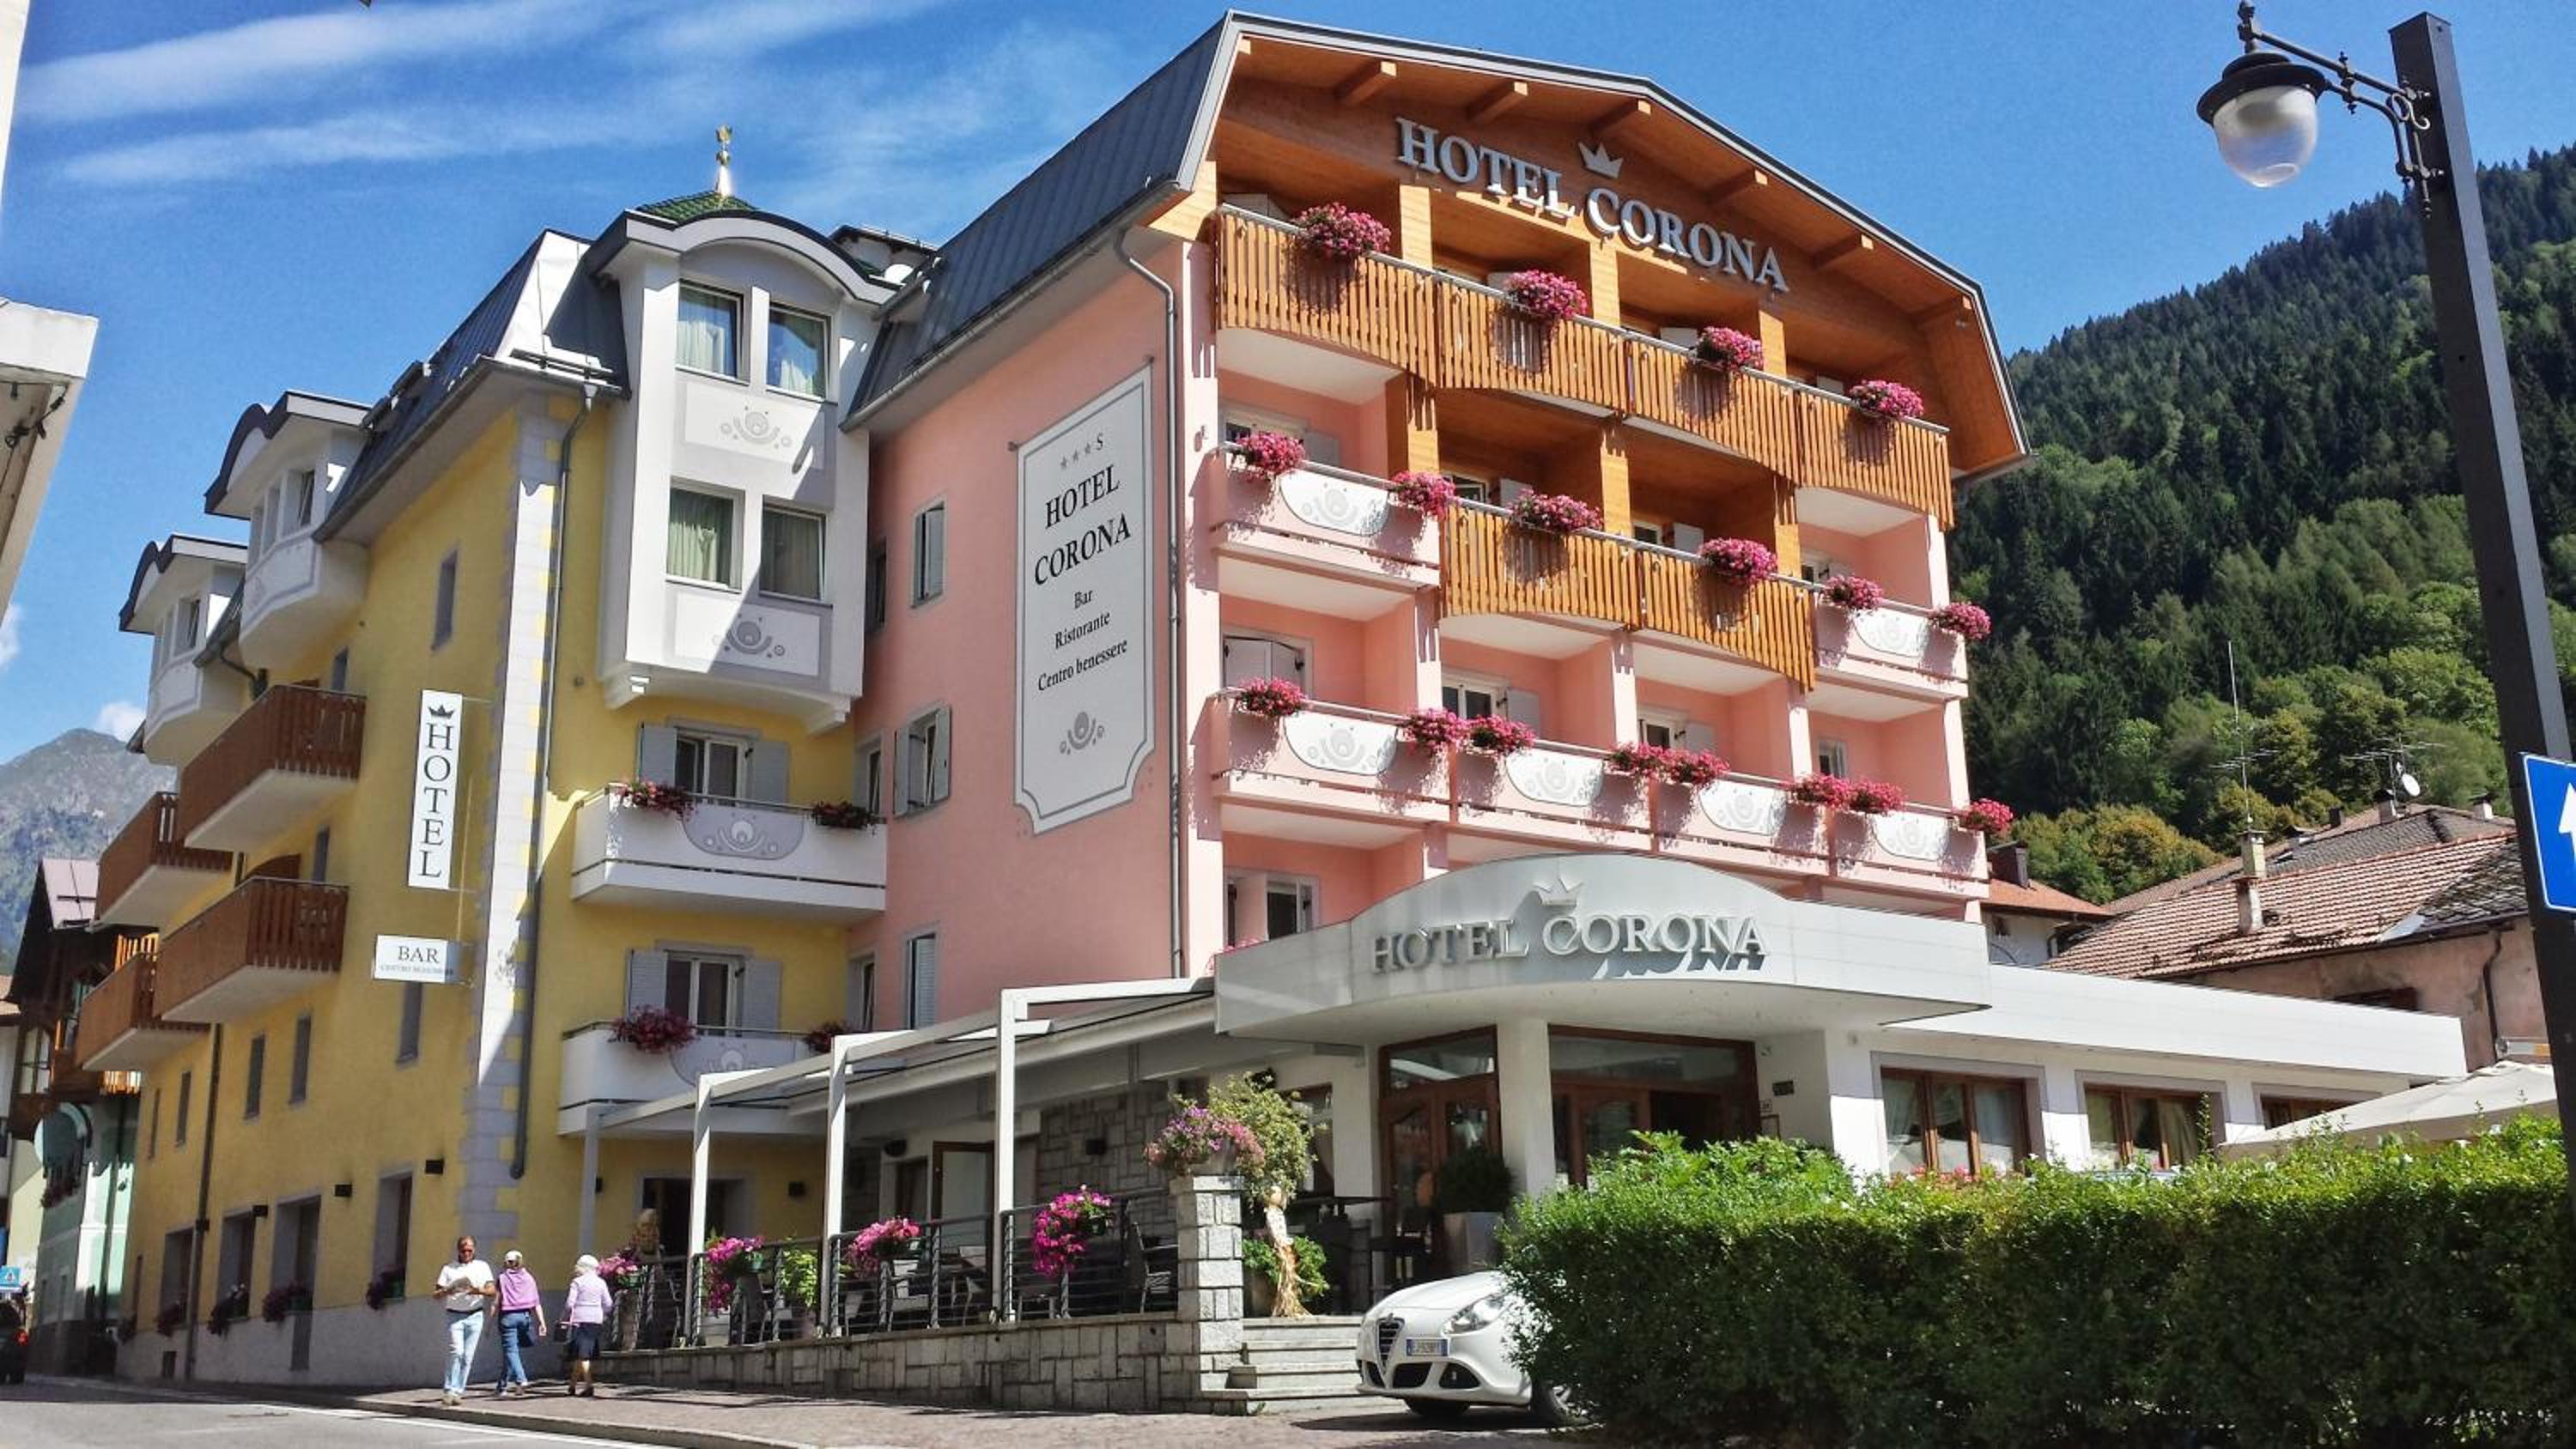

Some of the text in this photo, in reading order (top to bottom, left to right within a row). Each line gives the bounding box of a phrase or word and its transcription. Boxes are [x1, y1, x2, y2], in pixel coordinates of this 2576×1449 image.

[1396, 118, 1789, 293] HOTEL CORONA
[1096, 433, 1104, 451] S
[1045, 464, 1121, 529] HOTEL
[1035, 512, 1131, 585] CORONA
[1073, 590, 1093, 609] Bar
[1054, 612, 1110, 650] Ristorante
[1038, 640, 1127, 691] Centro benessere
[420, 722, 454, 878] HOTEL
[398, 945, 440, 963] BAR
[1373, 913, 1770, 974] HOTEL CORONA
